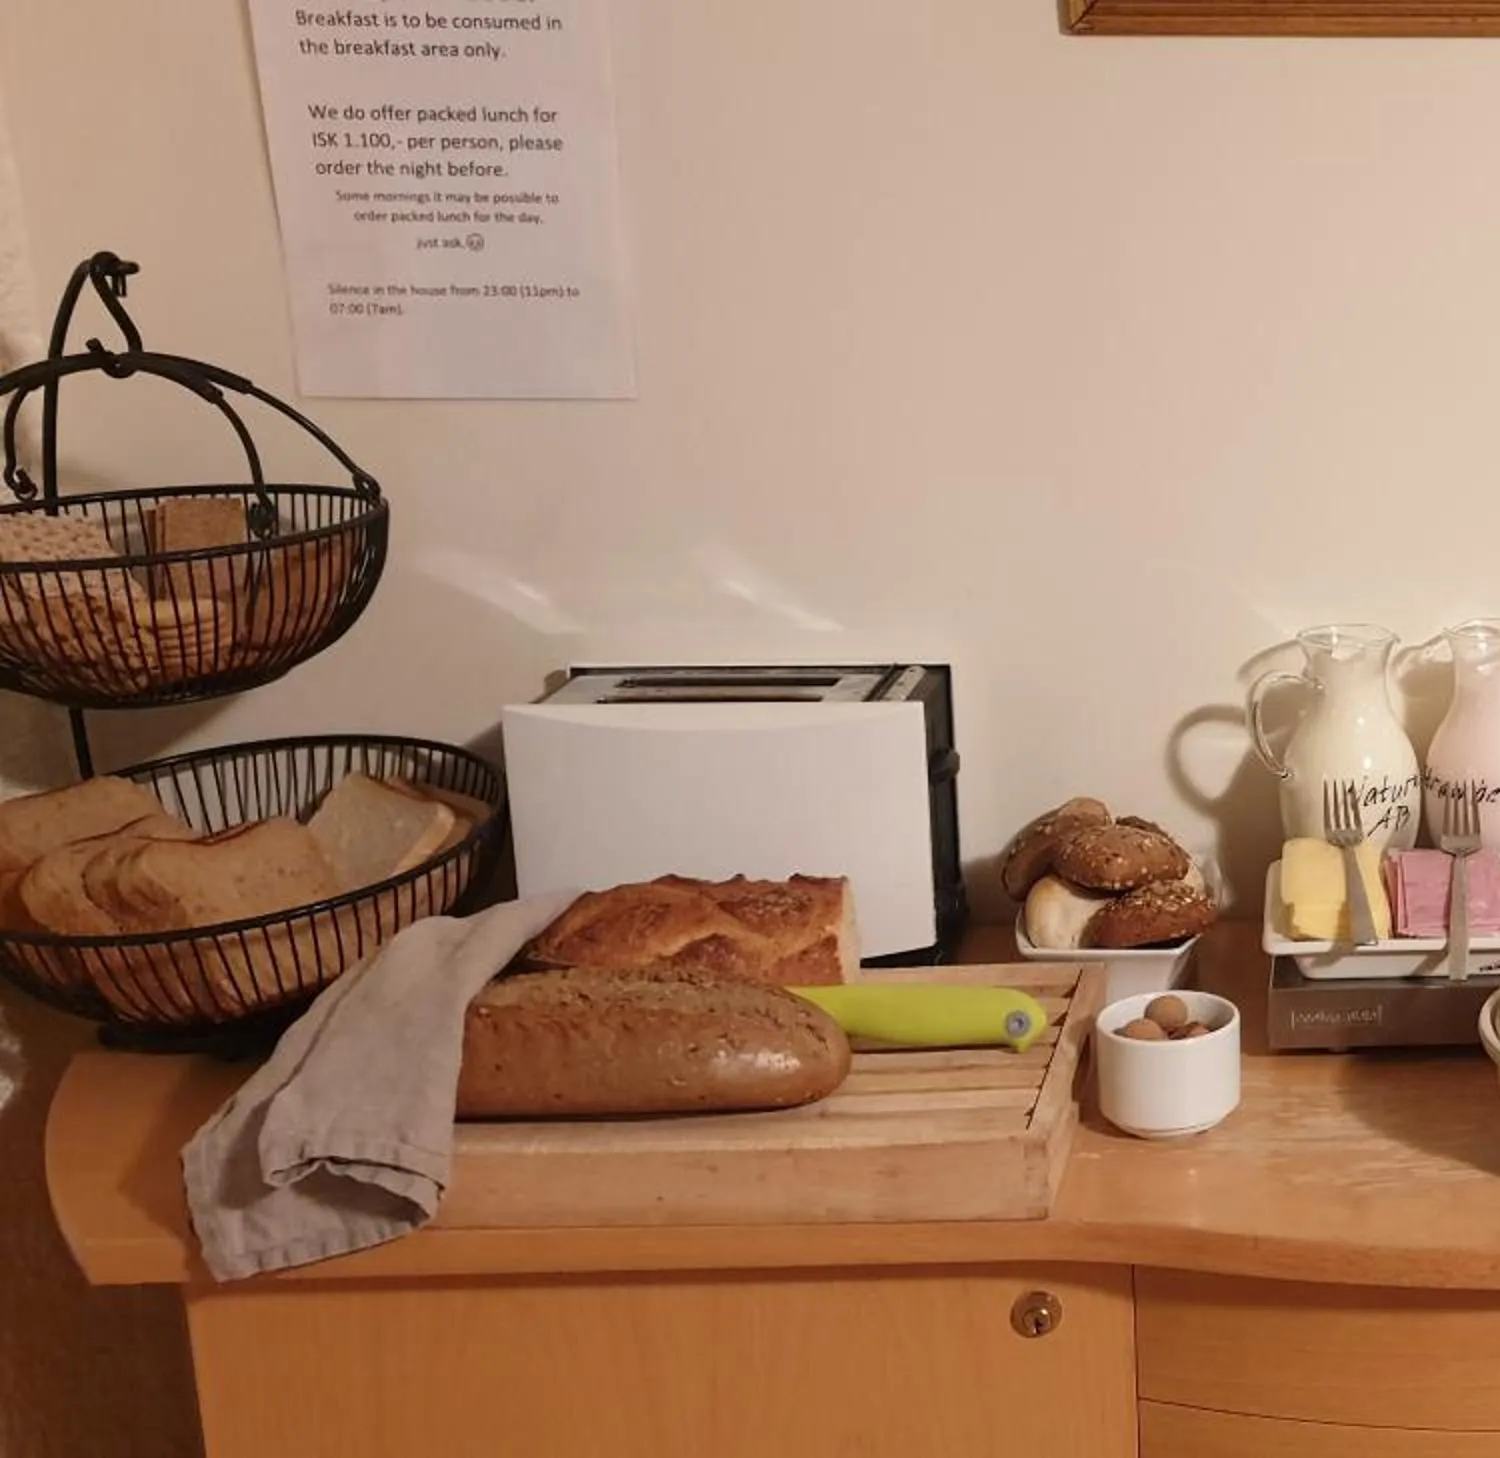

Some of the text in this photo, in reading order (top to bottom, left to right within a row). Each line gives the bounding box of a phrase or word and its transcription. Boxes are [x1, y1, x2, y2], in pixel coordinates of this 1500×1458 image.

[295, 9, 562, 31] Breakfast is to be consumed in
[299, 39, 506, 60] the breakfast area only.
[307, 105, 558, 126] We do offer packed lunch for
[312, 132, 339, 148] ISK
[406, 137, 436, 153] per
[440, 138, 503, 154] person,
[508, 134, 562, 154] please
[314, 160, 508, 180] order the night before.
[335, 190, 560, 207] Some mornings it may be possible to
[353, 209, 387, 222] order
[390, 209, 435, 225] packed
[436, 210, 471, 223] lunch
[473, 210, 491, 223] for
[494, 211, 515, 223] the
[372, 286, 385, 296] in
[386, 284, 408, 296] the
[410, 284, 448, 297] house
[449, 284, 481, 297] from
[566, 285, 581, 298] to
